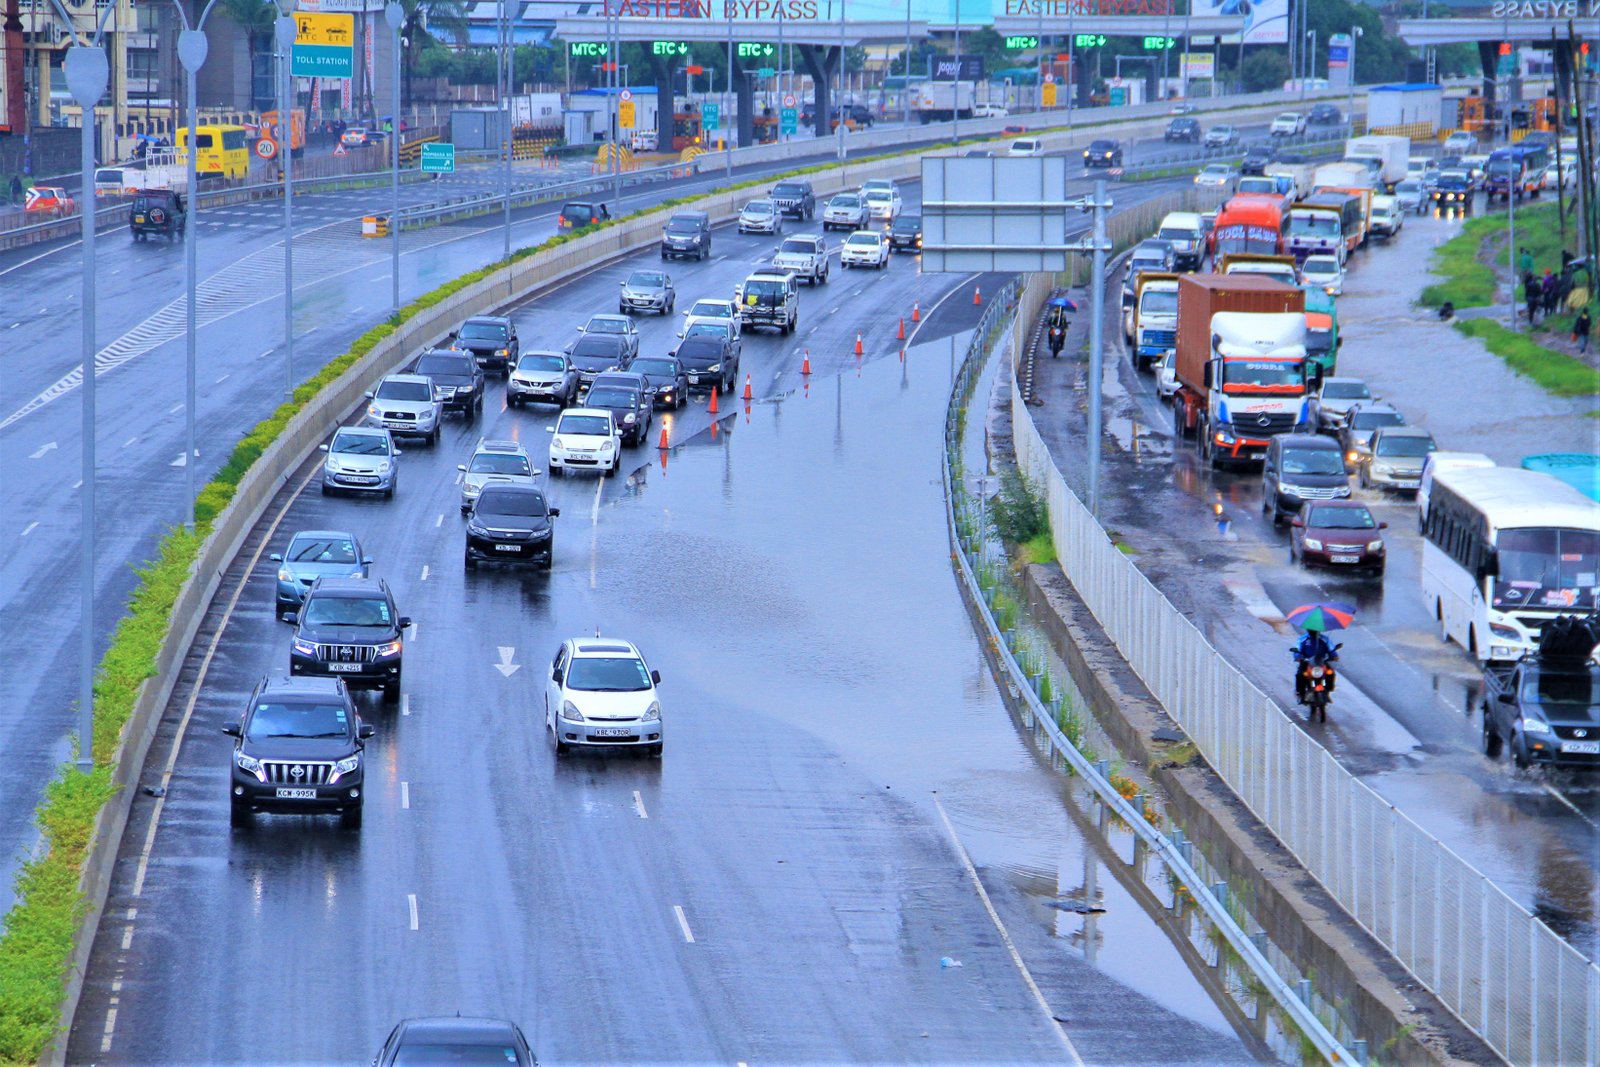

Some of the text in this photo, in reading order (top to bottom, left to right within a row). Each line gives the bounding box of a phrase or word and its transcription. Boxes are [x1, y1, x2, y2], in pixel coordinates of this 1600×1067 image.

[604, 0, 818, 20] EASTERN BYPASS
[1005, 0, 1177, 16] EASTERN BYPASS
[1006, 37, 1029, 49] MTC
[1076, 35, 1096, 47] ETC
[1144, 37, 1165, 49] ETC
[571, 43, 598, 56] MTC
[653, 41, 676, 55] ETC
[738, 43, 763, 57] ETC
[296, 56, 349, 66] TOLL STATION
[259, 143, 273, 154] 20
[295, 790, 316, 798] 995K
